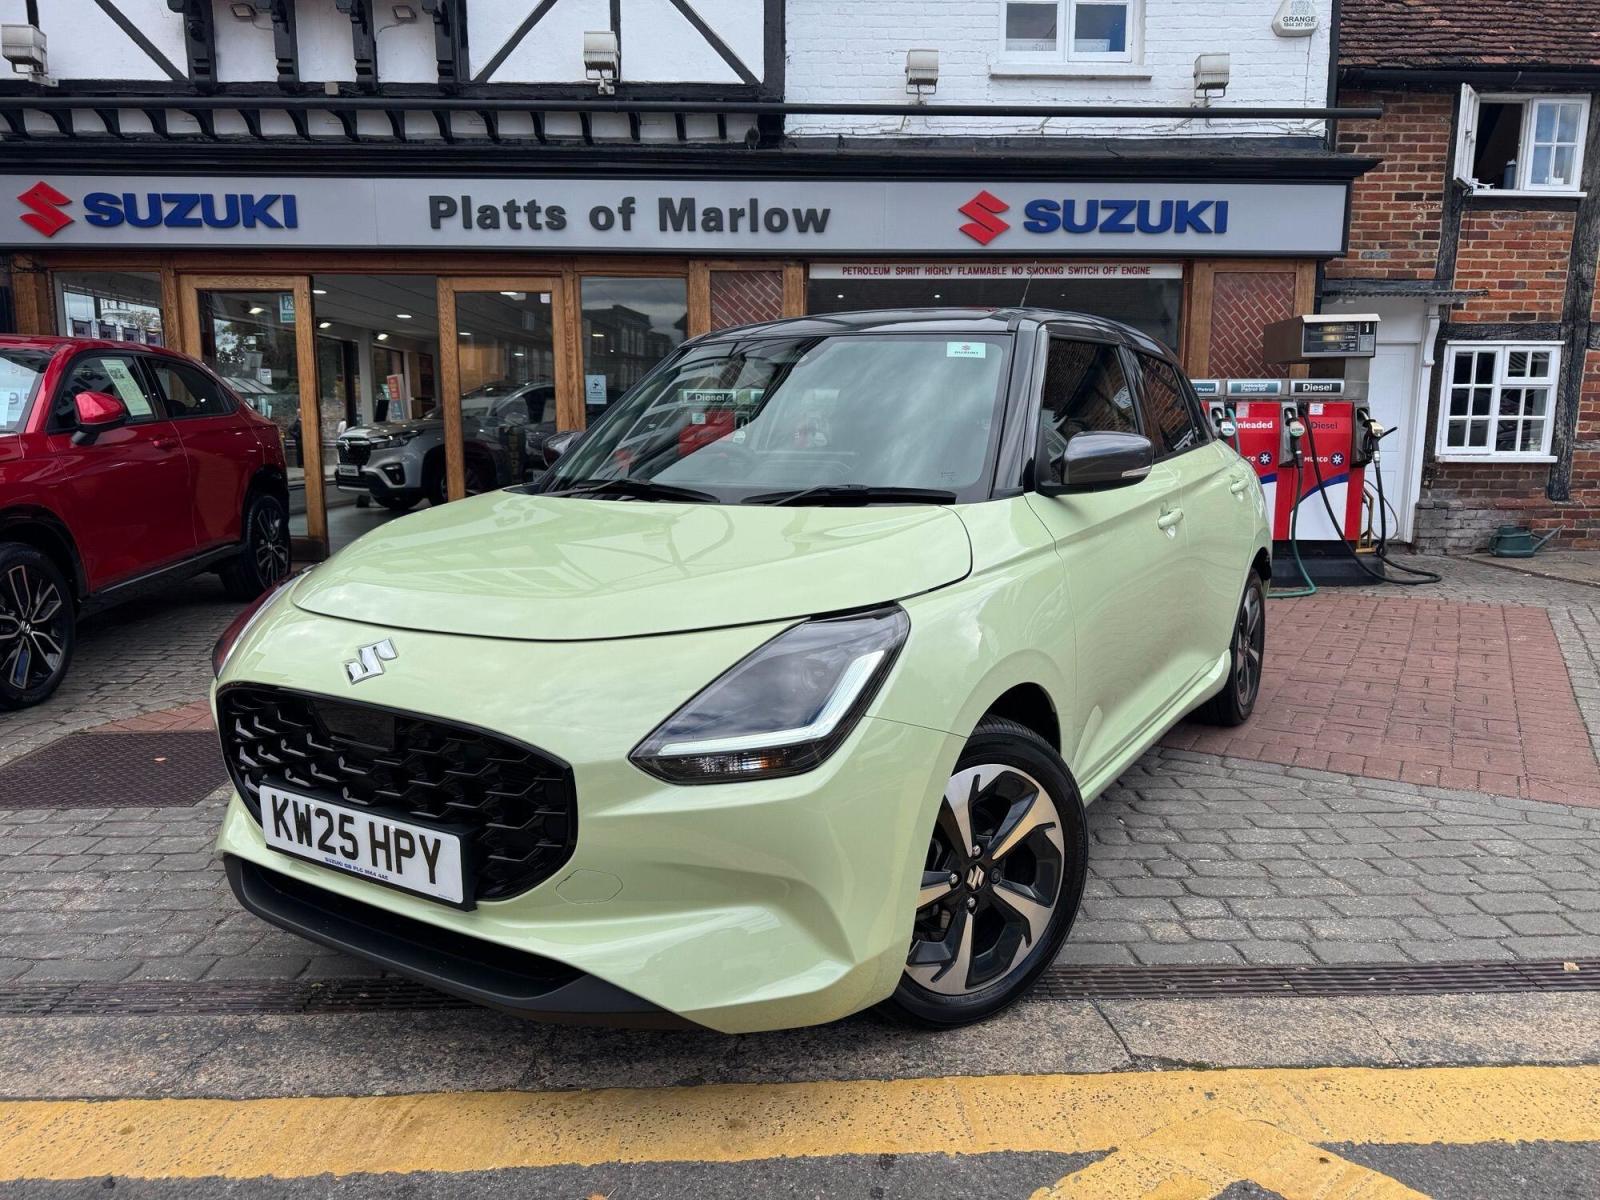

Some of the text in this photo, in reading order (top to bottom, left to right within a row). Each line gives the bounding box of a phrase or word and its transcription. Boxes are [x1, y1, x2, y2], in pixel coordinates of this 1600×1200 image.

[83, 192, 298, 229] SUZUKI
[429, 195, 831, 233] Platts of Marlow
[1024, 199, 1229, 234] SUZUKI
[842, 266, 1150, 275] PETROLEUM SPIRIT HIGHLY FLAMMABLE NO SMOKING SWITCH OFF ENGINE
[1365, 323, 1370, 333] 1
[1302, 383, 1333, 391] Diesel
[695, 393, 725, 401] Diesel
[1312, 422, 1338, 430] Diesel
[271, 794, 441, 884] KW25 HPY
